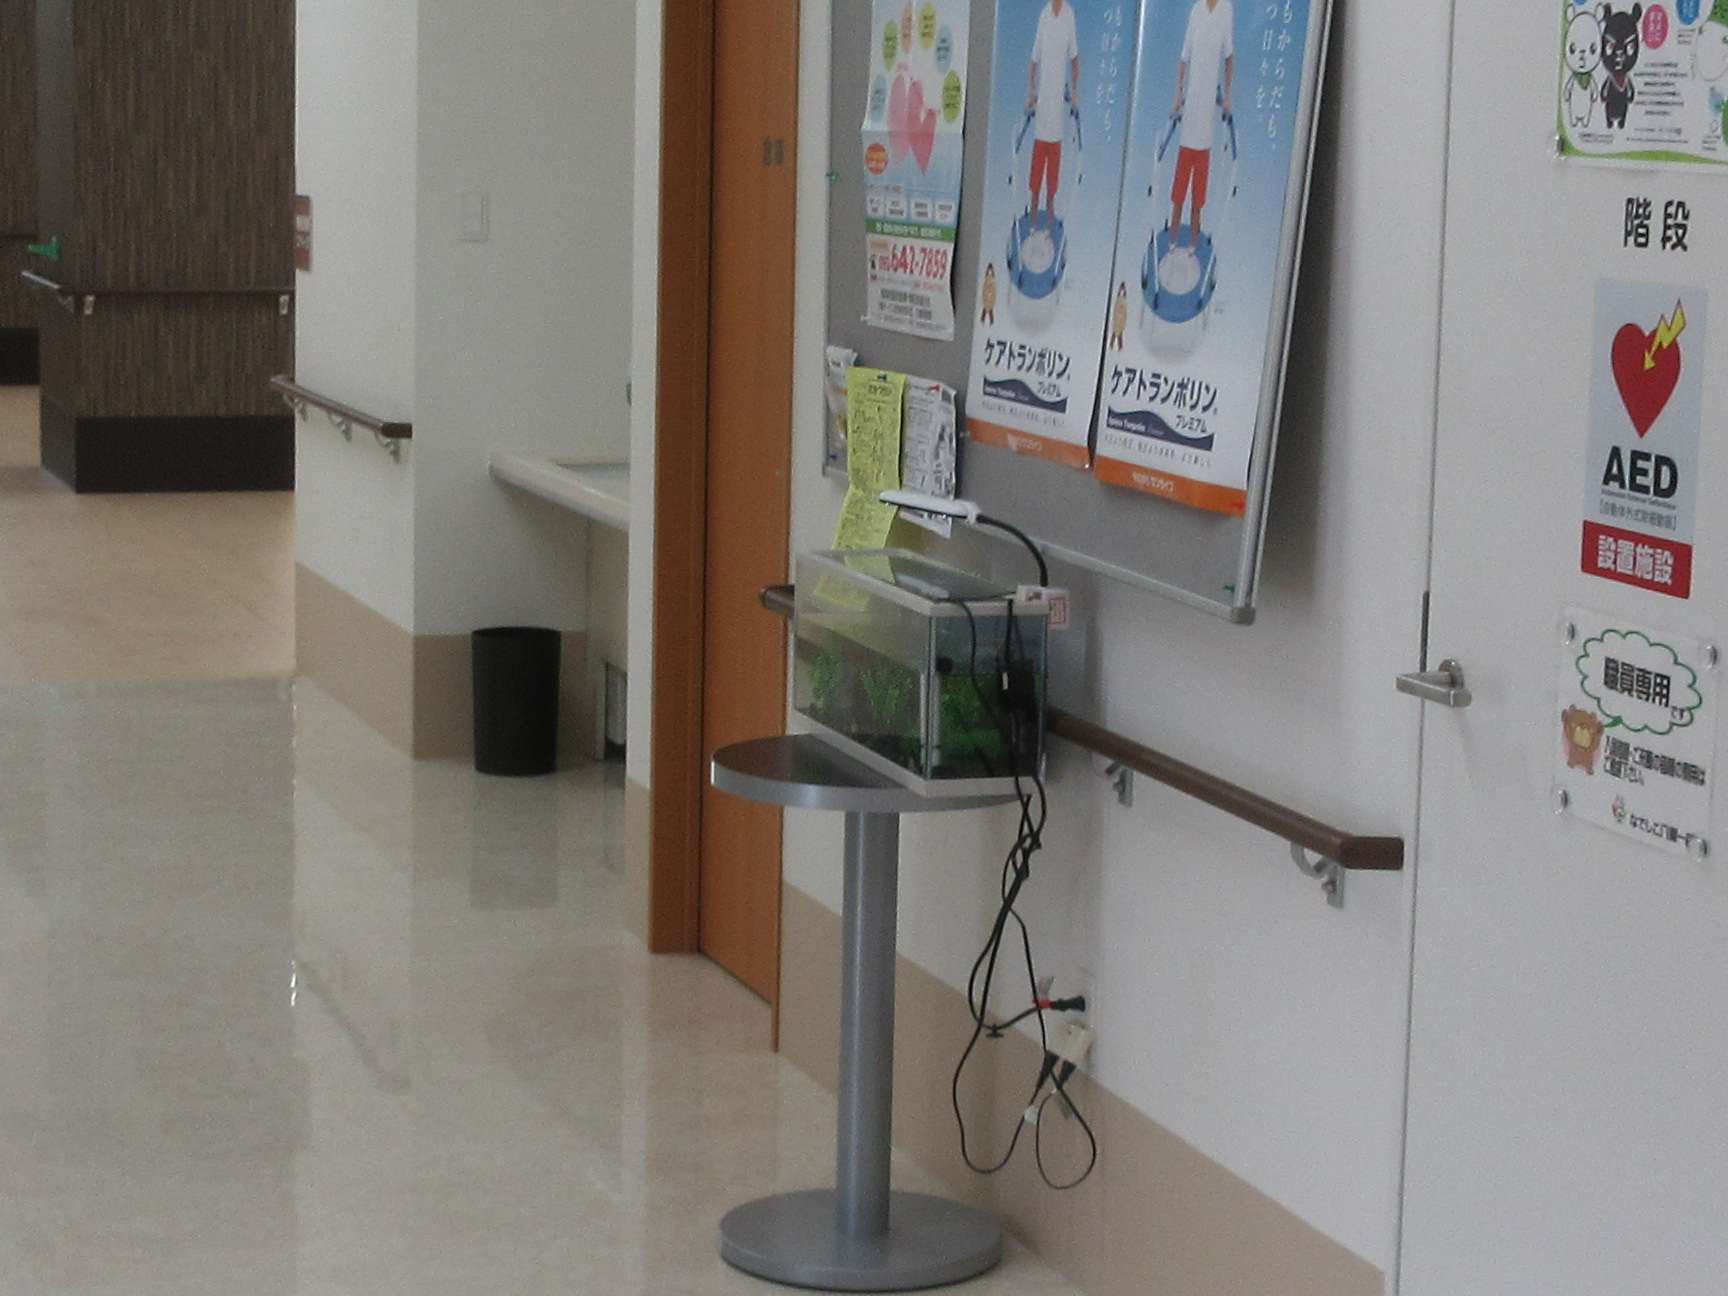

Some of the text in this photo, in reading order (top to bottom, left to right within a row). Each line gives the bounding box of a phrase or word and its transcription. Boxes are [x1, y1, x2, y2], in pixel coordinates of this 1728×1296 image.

[1623, 196, 1691, 252] 階段
[985, 336, 1070, 381] ケアトランポリン
[1110, 364, 1217, 415] ケアトランポリン
[1601, 444, 1679, 499] AED
[1597, 533, 1674, 586] 設置施設
